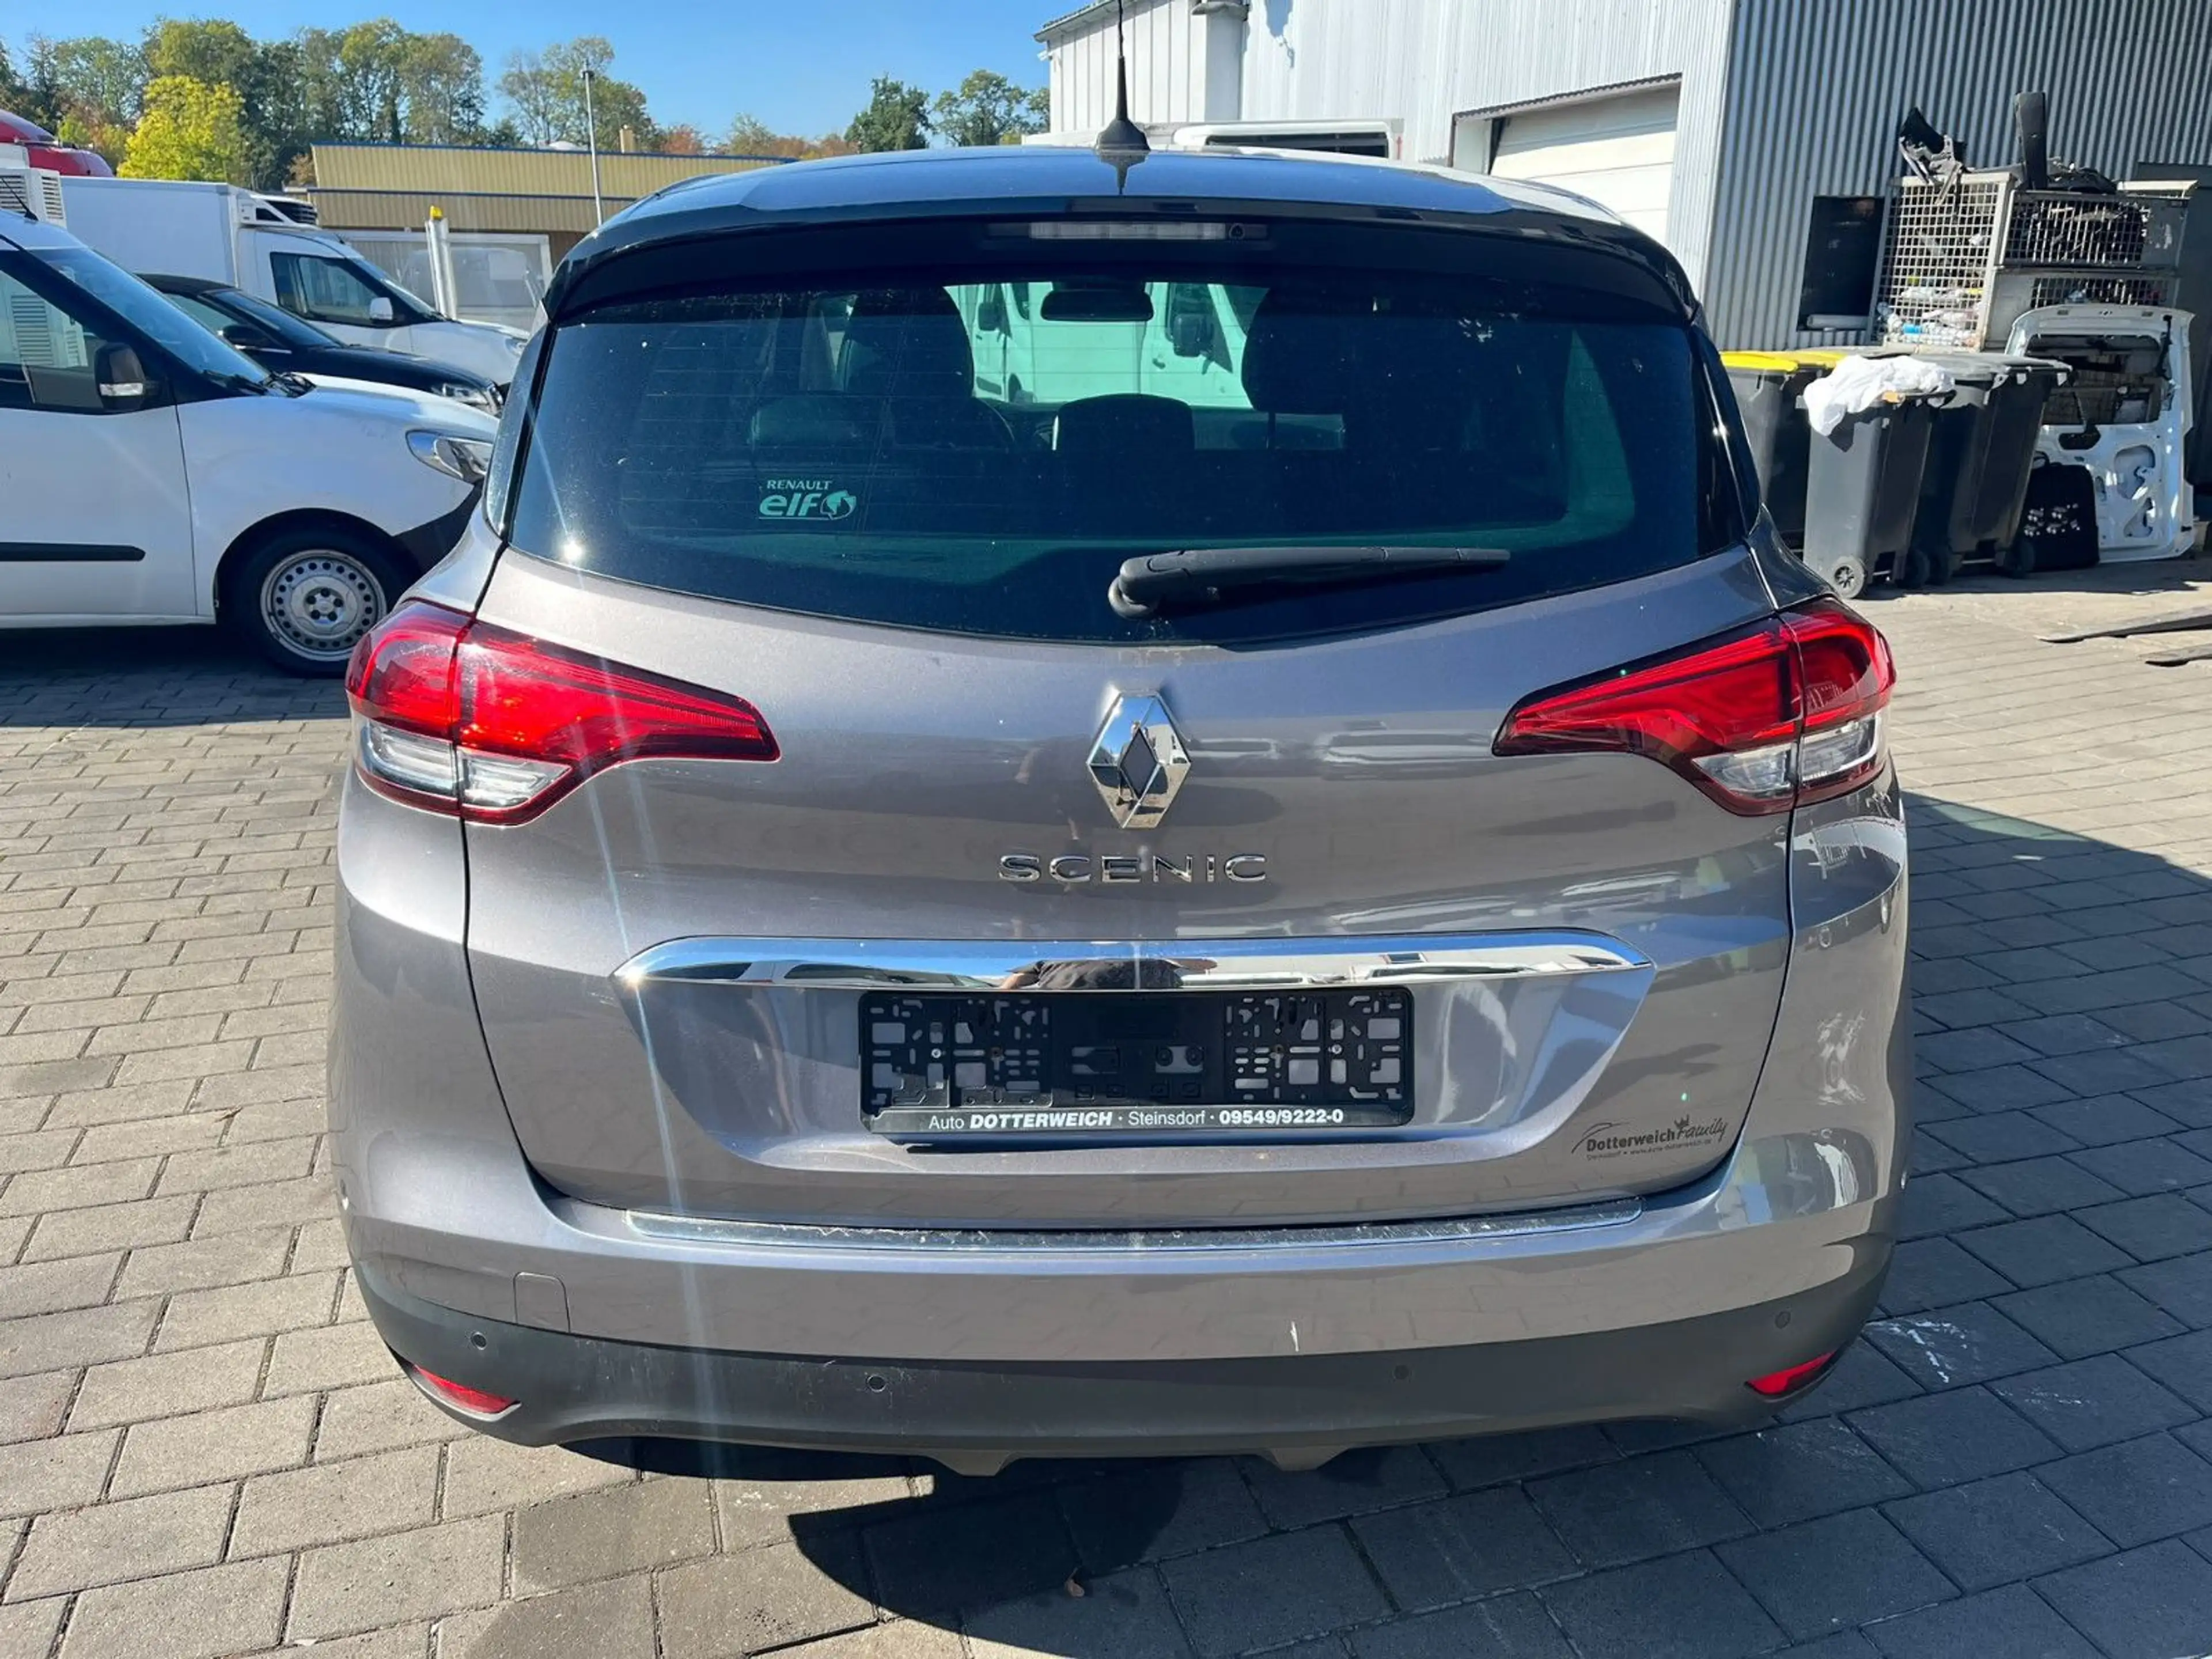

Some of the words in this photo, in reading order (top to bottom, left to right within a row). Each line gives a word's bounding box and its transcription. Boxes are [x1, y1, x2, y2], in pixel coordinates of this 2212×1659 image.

[767, 479, 832, 490] RENAULT
[759, 493, 822, 516] elf
[998, 854, 1266, 882] SCENIC
[929, 1115, 964, 1129] Auto
[970, 1111, 1112, 1128] DOTTERWEICH
[1128, 1110, 1206, 1126] Steinsdorf
[1219, 1108, 1344, 1124] 09549/9222-0
[1586, 1128, 1675, 1152] Dotterweich
